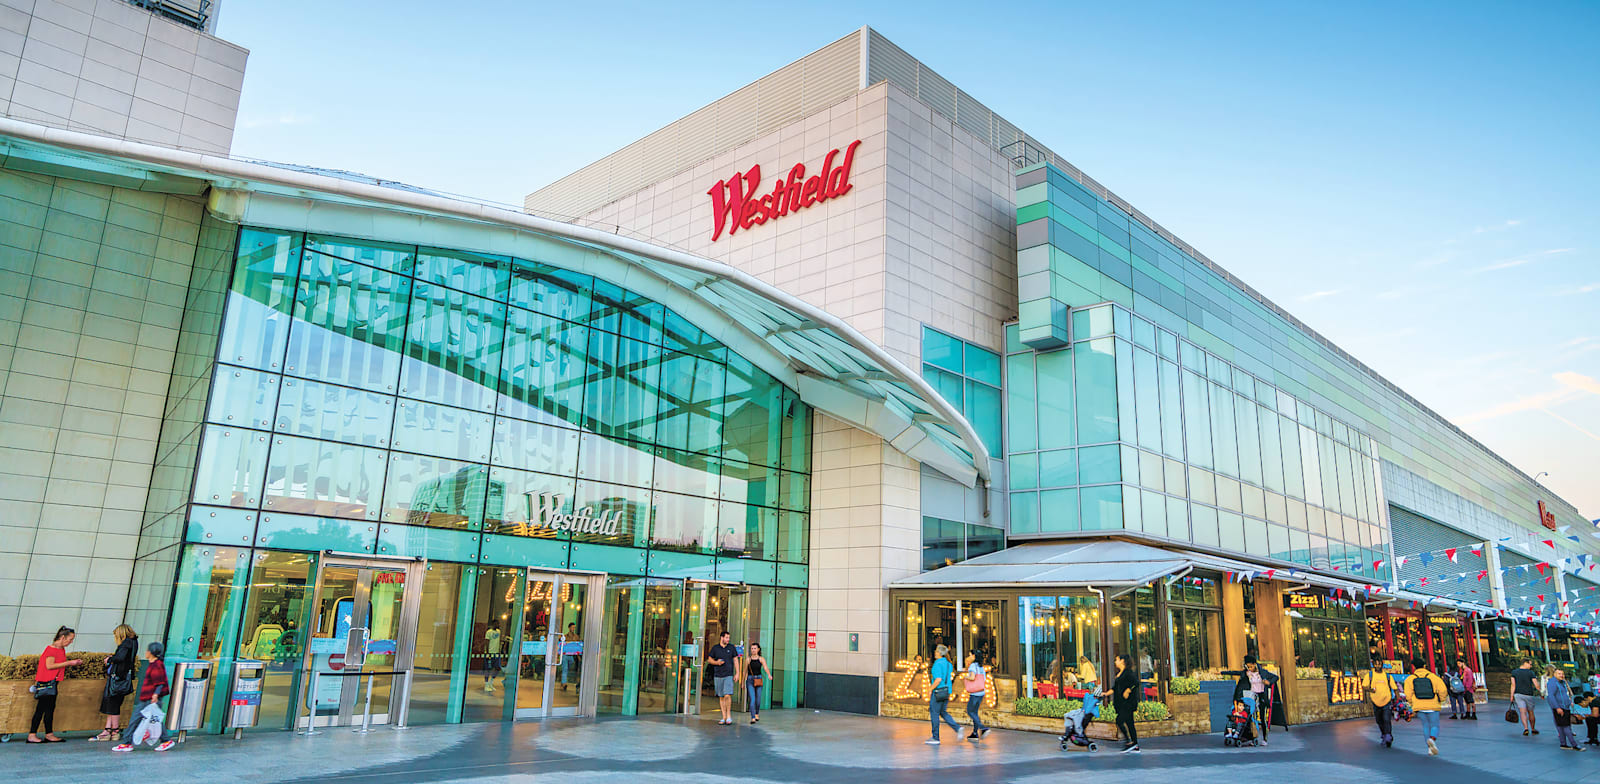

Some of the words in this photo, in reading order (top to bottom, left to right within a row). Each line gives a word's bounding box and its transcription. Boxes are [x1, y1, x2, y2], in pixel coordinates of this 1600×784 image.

[707, 139, 862, 242] Westfield
[523, 490, 623, 537] Westfield
[893, 660, 997, 708] Zii
